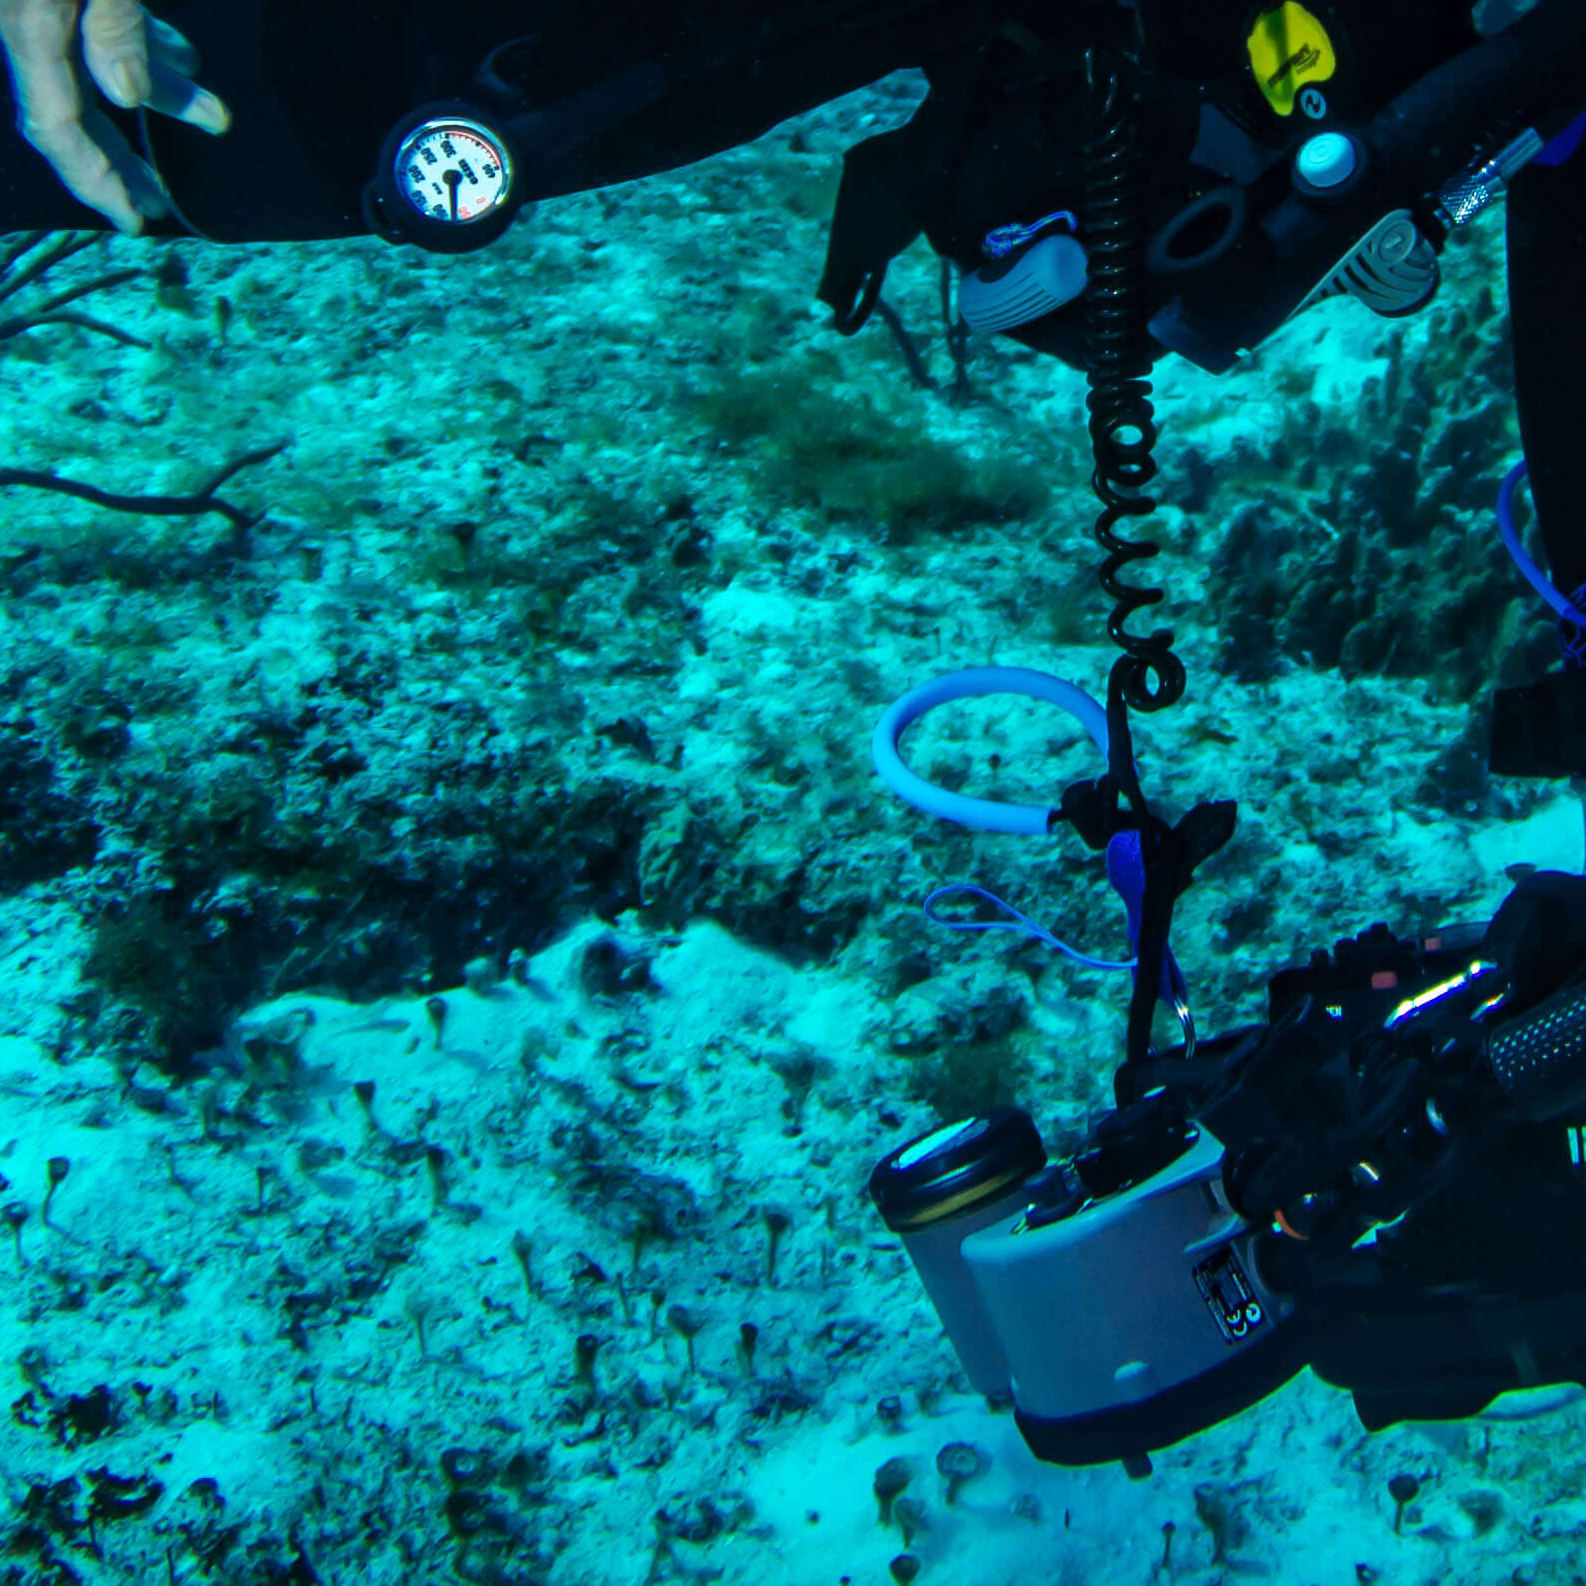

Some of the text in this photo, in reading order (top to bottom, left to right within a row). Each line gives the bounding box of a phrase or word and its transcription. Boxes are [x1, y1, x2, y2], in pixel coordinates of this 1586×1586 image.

[421, 148, 437, 165] 250
[440, 140, 456, 158] 300
[408, 165, 425, 183] 200
